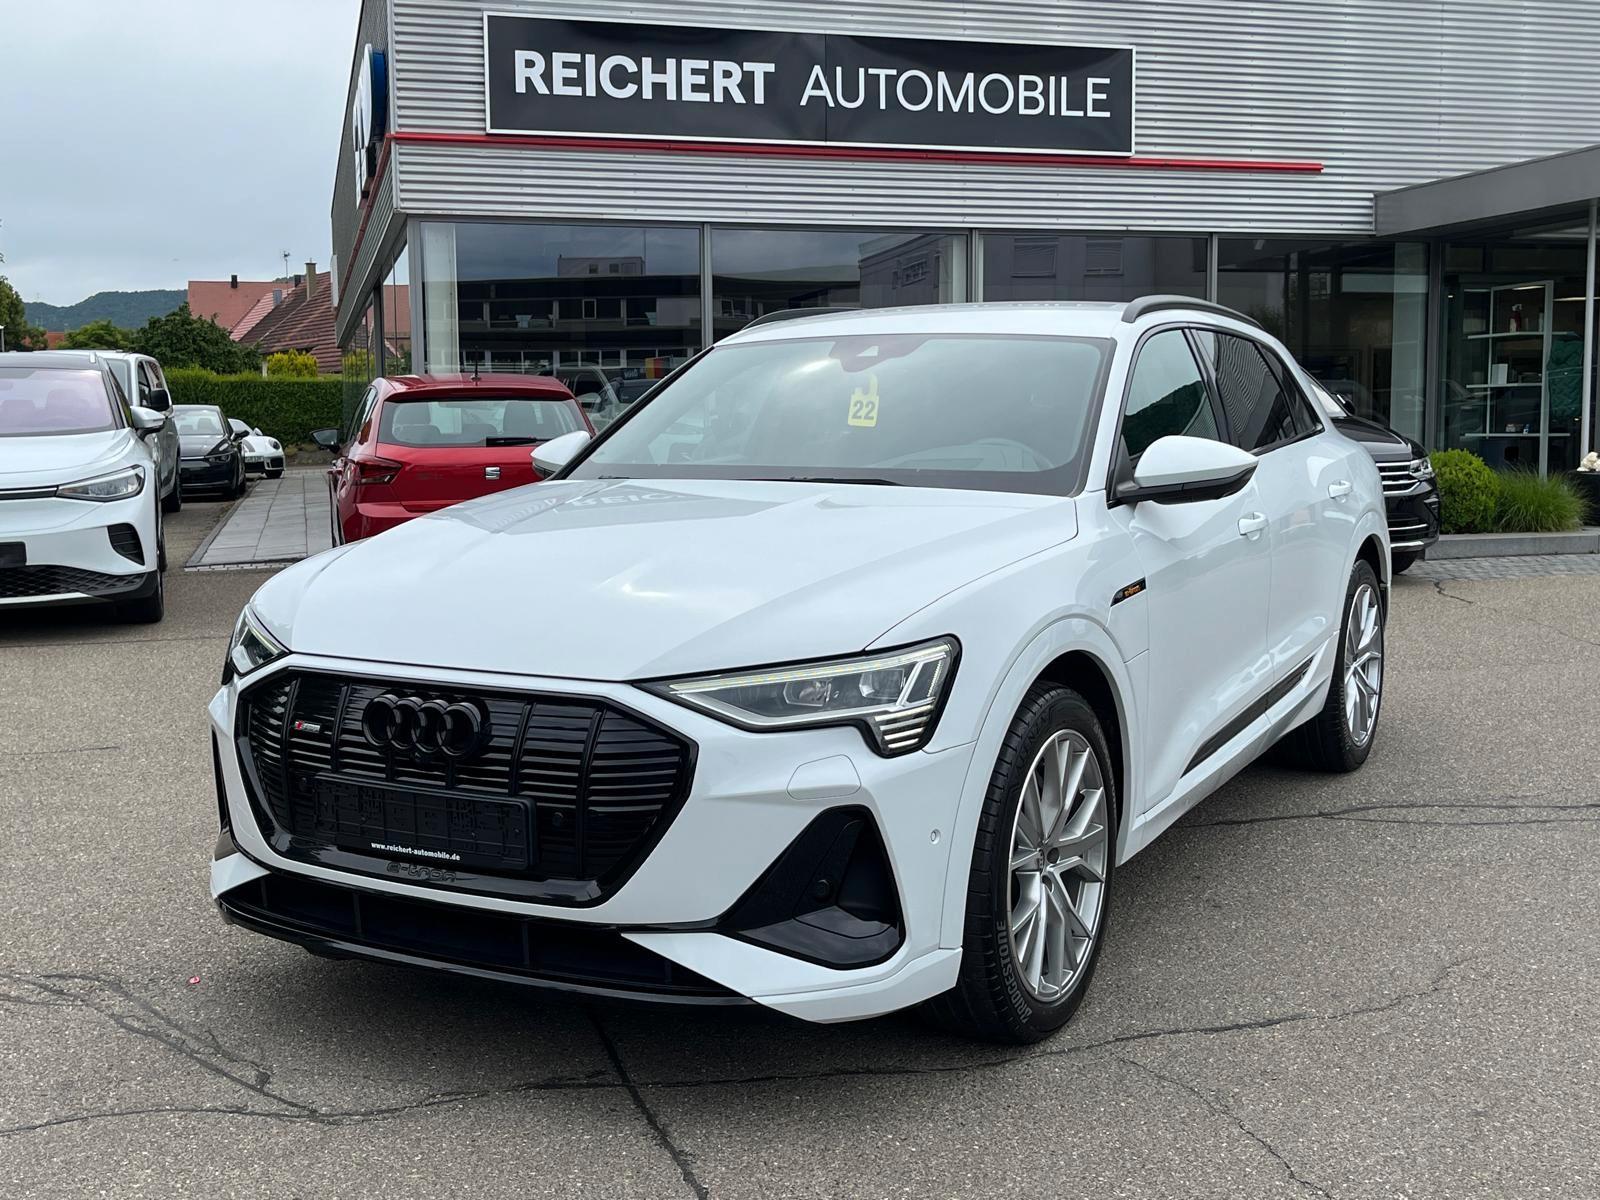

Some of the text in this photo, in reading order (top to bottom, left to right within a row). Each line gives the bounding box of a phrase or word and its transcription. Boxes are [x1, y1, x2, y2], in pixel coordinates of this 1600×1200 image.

[514, 50, 1111, 118] REICHERT AUTOMOBILE
[851, 400, 876, 421] 22
[370, 842, 461, 861] www.reichert-automobile.de
[996, 920, 1033, 1024] BRIDGESTONE
